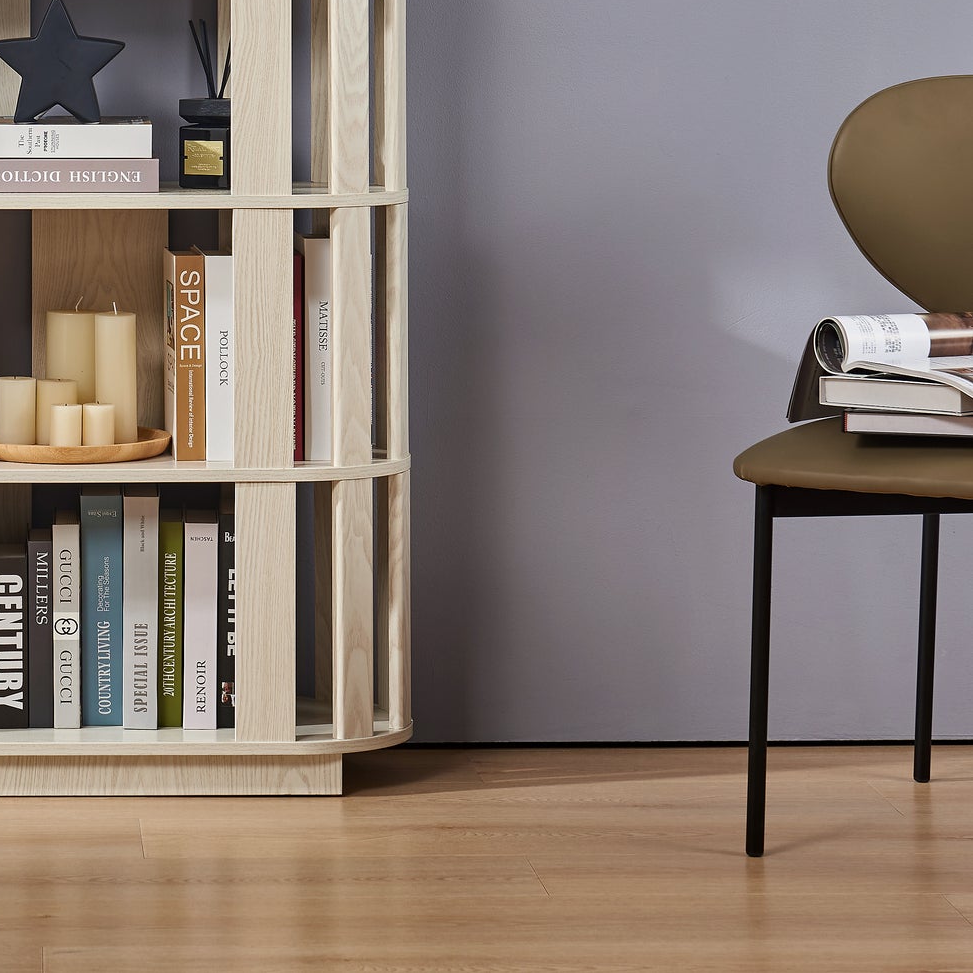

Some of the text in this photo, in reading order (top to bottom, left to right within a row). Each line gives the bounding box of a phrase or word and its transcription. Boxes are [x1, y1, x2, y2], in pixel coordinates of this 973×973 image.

[70, 171, 141, 183] ENGLISH
[179, 270, 201, 361] SPACE
[319, 301, 328, 351] MATISSE
[220, 331, 228, 385] POLLOCK
[36, 552, 48, 625] MILLERS
[60, 549, 71, 603] GUCCI
[60, 650, 72, 704] GUCCI
[97, 621, 111, 715] COUNTRY LIVING
[134, 623, 148, 712] SPECIAL ISSUE
[196, 660, 206, 713] RENOIR
